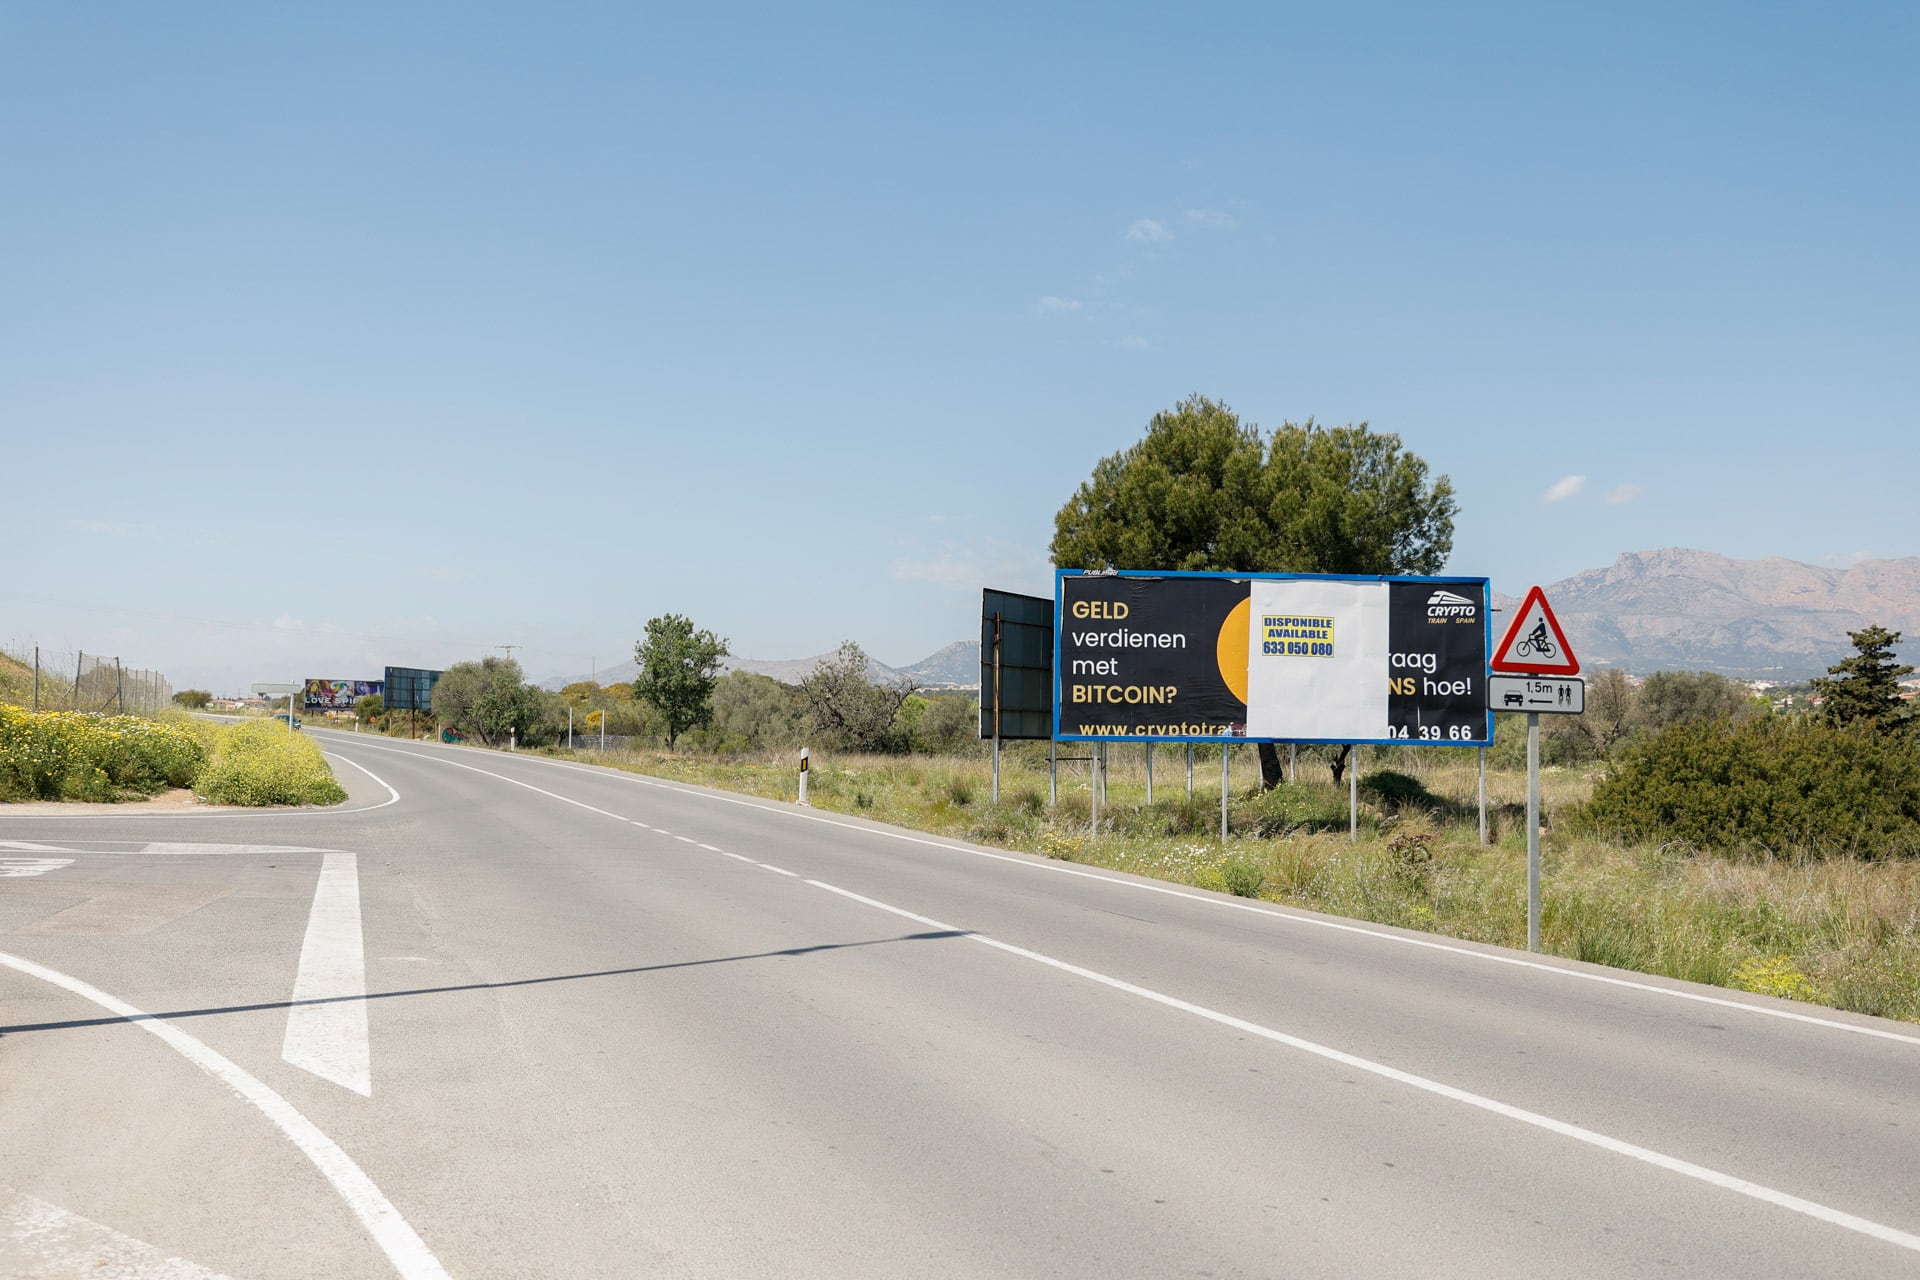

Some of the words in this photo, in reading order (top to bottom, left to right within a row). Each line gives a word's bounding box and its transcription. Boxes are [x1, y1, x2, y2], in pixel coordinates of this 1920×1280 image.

[1072, 601, 1129, 619] GELD
[1427, 606, 1476, 616] CRYPTO
[1264, 617, 1332, 628] DISPONIBLE
[1072, 628, 1186, 648] verdienen
[1268, 629, 1328, 639] AVAILABLE
[1263, 641, 1285, 654] 633
[1287, 641, 1309, 655] 050
[1311, 642, 1333, 656] 080
[1072, 657, 1118, 676] met
[1423, 677, 1472, 695] hoe!
[1072, 685, 1178, 704] BITCOIN?
[1418, 725, 1441, 740] 39
[1449, 725, 1472, 740] 66
